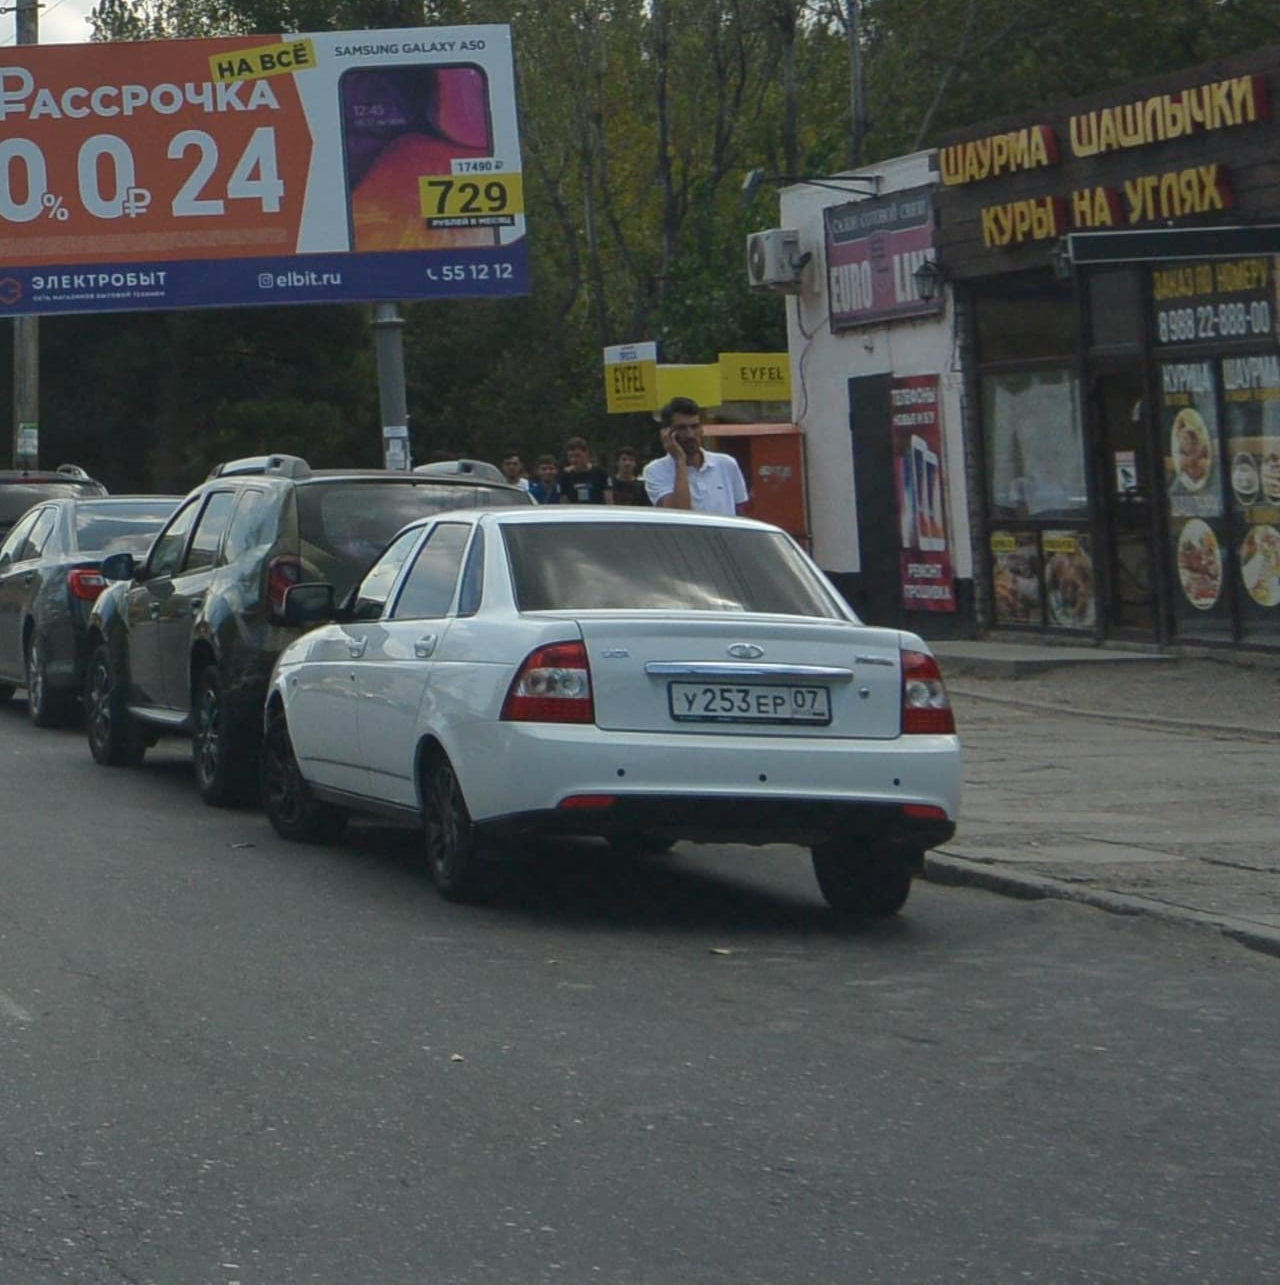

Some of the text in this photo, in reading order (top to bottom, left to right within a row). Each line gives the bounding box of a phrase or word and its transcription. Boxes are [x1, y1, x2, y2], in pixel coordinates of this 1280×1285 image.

[218, 44, 309, 80] НА ВСЁ
[335, 40, 486, 57] SAMSUNG GALAXY A50
[940, 75, 1257, 187] ШАУРМА ШАШЛЫЧКИ
[167, 126, 285, 216] 24
[458, 161, 492, 172] 17490
[427, 180, 509, 215] 729
[981, 163, 1224, 248] КУРЫ НА УГЛЯХ
[31, 272, 167, 290] ЭЛЕКТРОБЫТ
[276, 270, 342, 287] elbit.ru
[442, 263, 514, 281] 55 12 12
[830, 260, 873, 313] EURO
[613, 365, 646, 395] EYFEL
[741, 366, 785, 381] EYFEL
